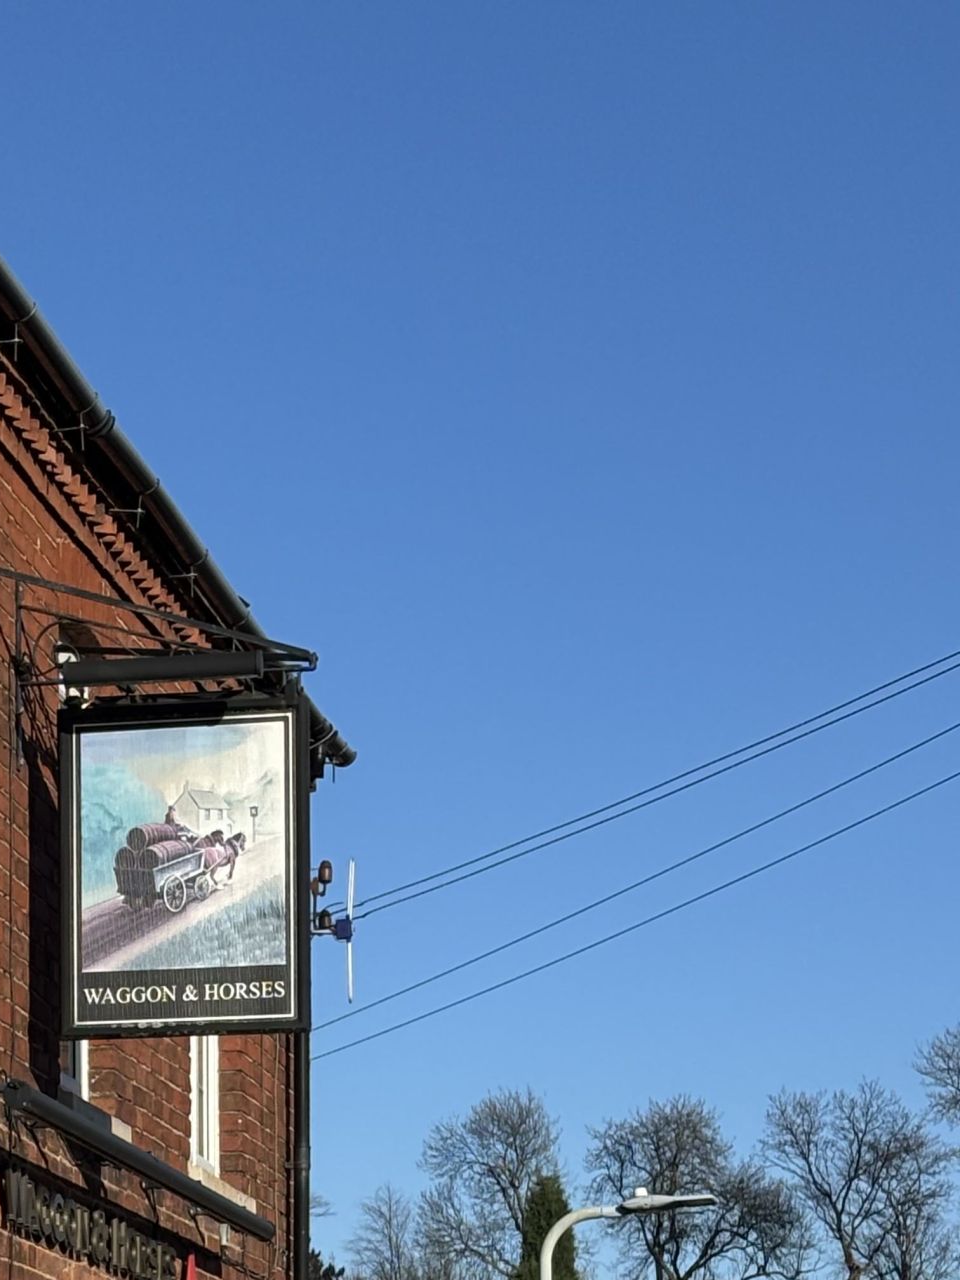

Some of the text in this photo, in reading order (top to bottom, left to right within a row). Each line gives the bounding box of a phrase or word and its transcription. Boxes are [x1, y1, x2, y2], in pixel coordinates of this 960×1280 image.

[83, 980, 286, 1005] WAGGON & HORSES
